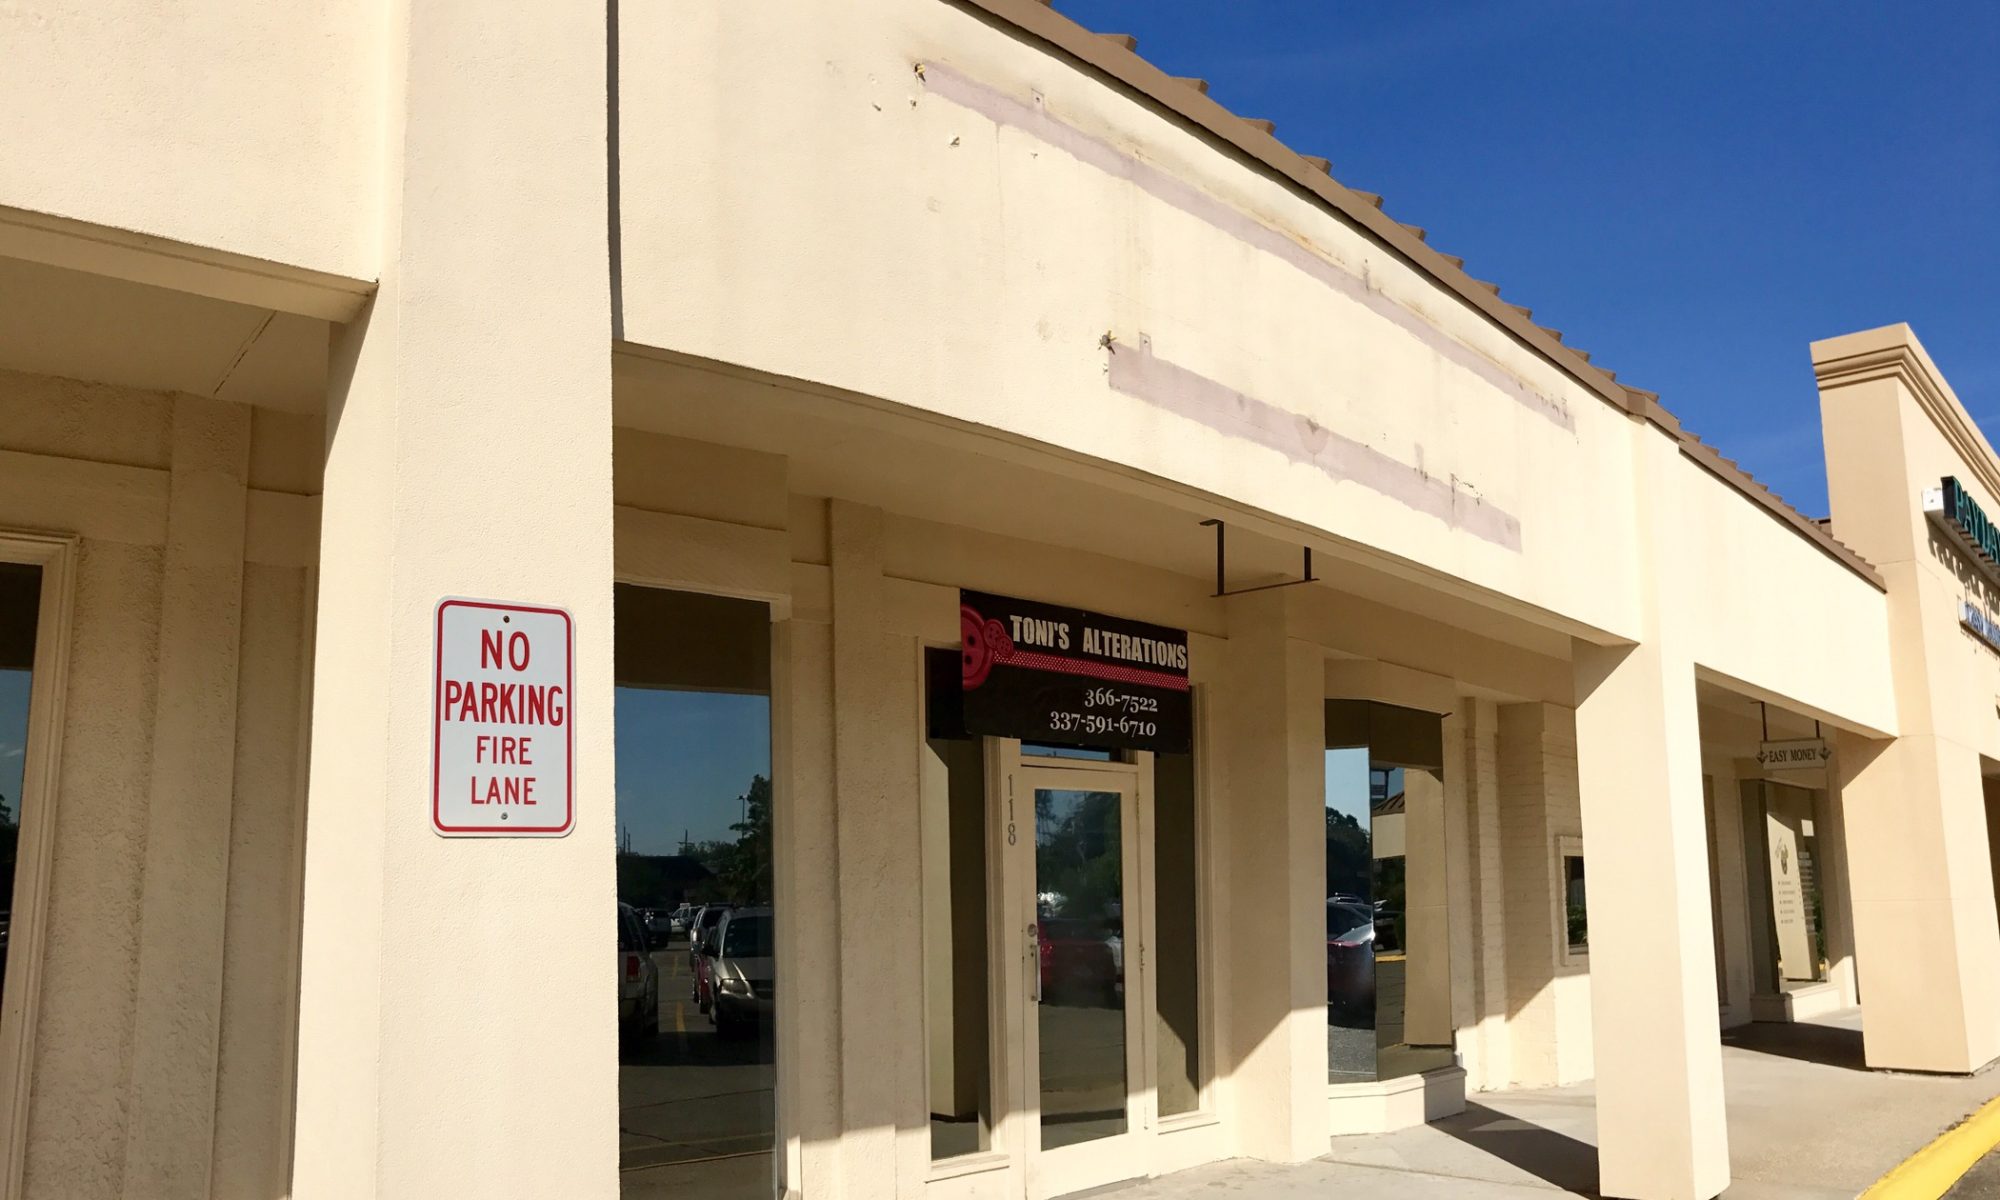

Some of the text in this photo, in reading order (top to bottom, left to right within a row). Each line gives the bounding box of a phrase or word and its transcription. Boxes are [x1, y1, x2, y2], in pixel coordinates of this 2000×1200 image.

[1945, 476, 2000, 567] PAYDA
[481, 629, 530, 671] NO
[1009, 614, 1187, 670] TONI'S ALTERATIONS
[444, 680, 563, 726] PARKING
[1084, 687, 1158, 714] 366-7522
[1050, 711, 1157, 738] 337-591-6710
[476, 735, 532, 764] FIRE
[1769, 748, 1817, 763] EASY MONEY
[471, 776, 537, 805] LANE
[1008, 774, 1016, 846] 118
